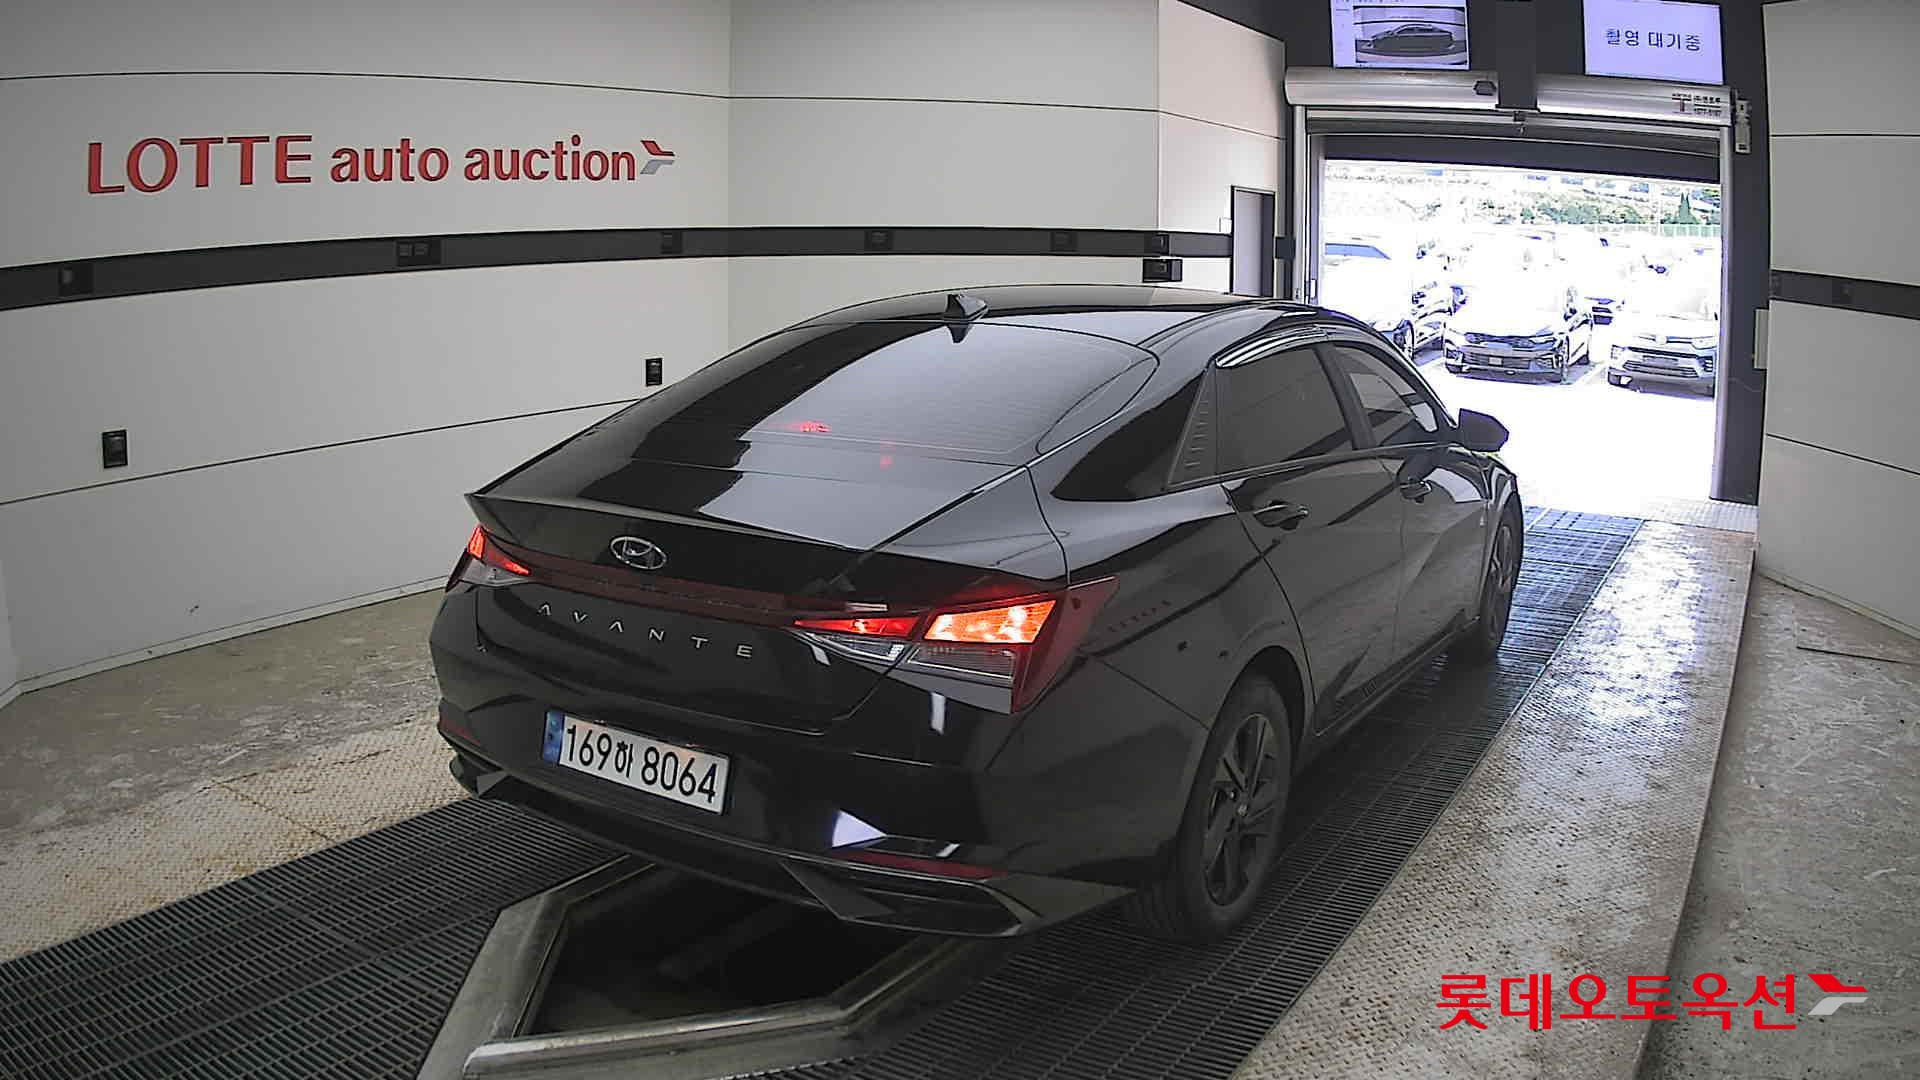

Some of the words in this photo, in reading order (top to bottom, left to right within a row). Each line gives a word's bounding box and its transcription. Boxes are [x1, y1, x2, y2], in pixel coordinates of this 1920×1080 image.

[1648, 31, 1701, 52] 대기중
[88, 135, 313, 194] LOTTE
[330, 138, 450, 183] auto
[463, 135, 637, 183] auction
[537, 603, 753, 658] AVANTE
[567, 724, 634, 779] 169하
[641, 746, 717, 804] 8064
